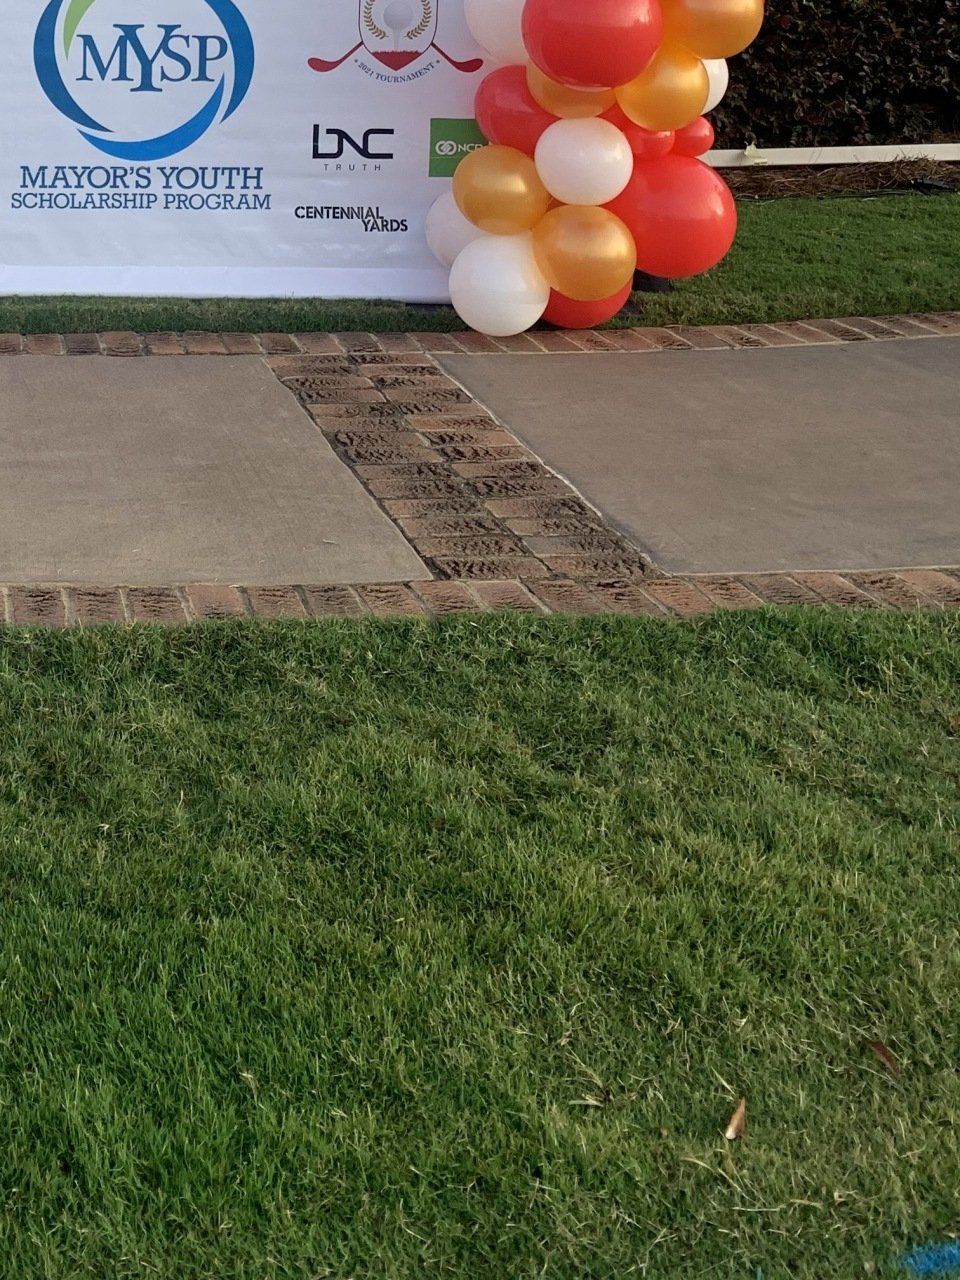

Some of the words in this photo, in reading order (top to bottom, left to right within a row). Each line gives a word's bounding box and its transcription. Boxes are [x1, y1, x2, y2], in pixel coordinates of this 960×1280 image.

[76, 24, 228, 92] MYSP
[358, 63, 374, 78] 2021
[375, 64, 436, 83] TOURNAMENT
[323, 163, 381, 171] TRUTH
[19, 165, 152, 190] MAYOR'S
[157, 166, 264, 190] YOUTH
[11, 192, 158, 210] SCHOLARSHIP
[162, 193, 271, 211] PROGRAM
[294, 206, 384, 220] CENTENNIAL
[361, 219, 408, 233] YARDS
